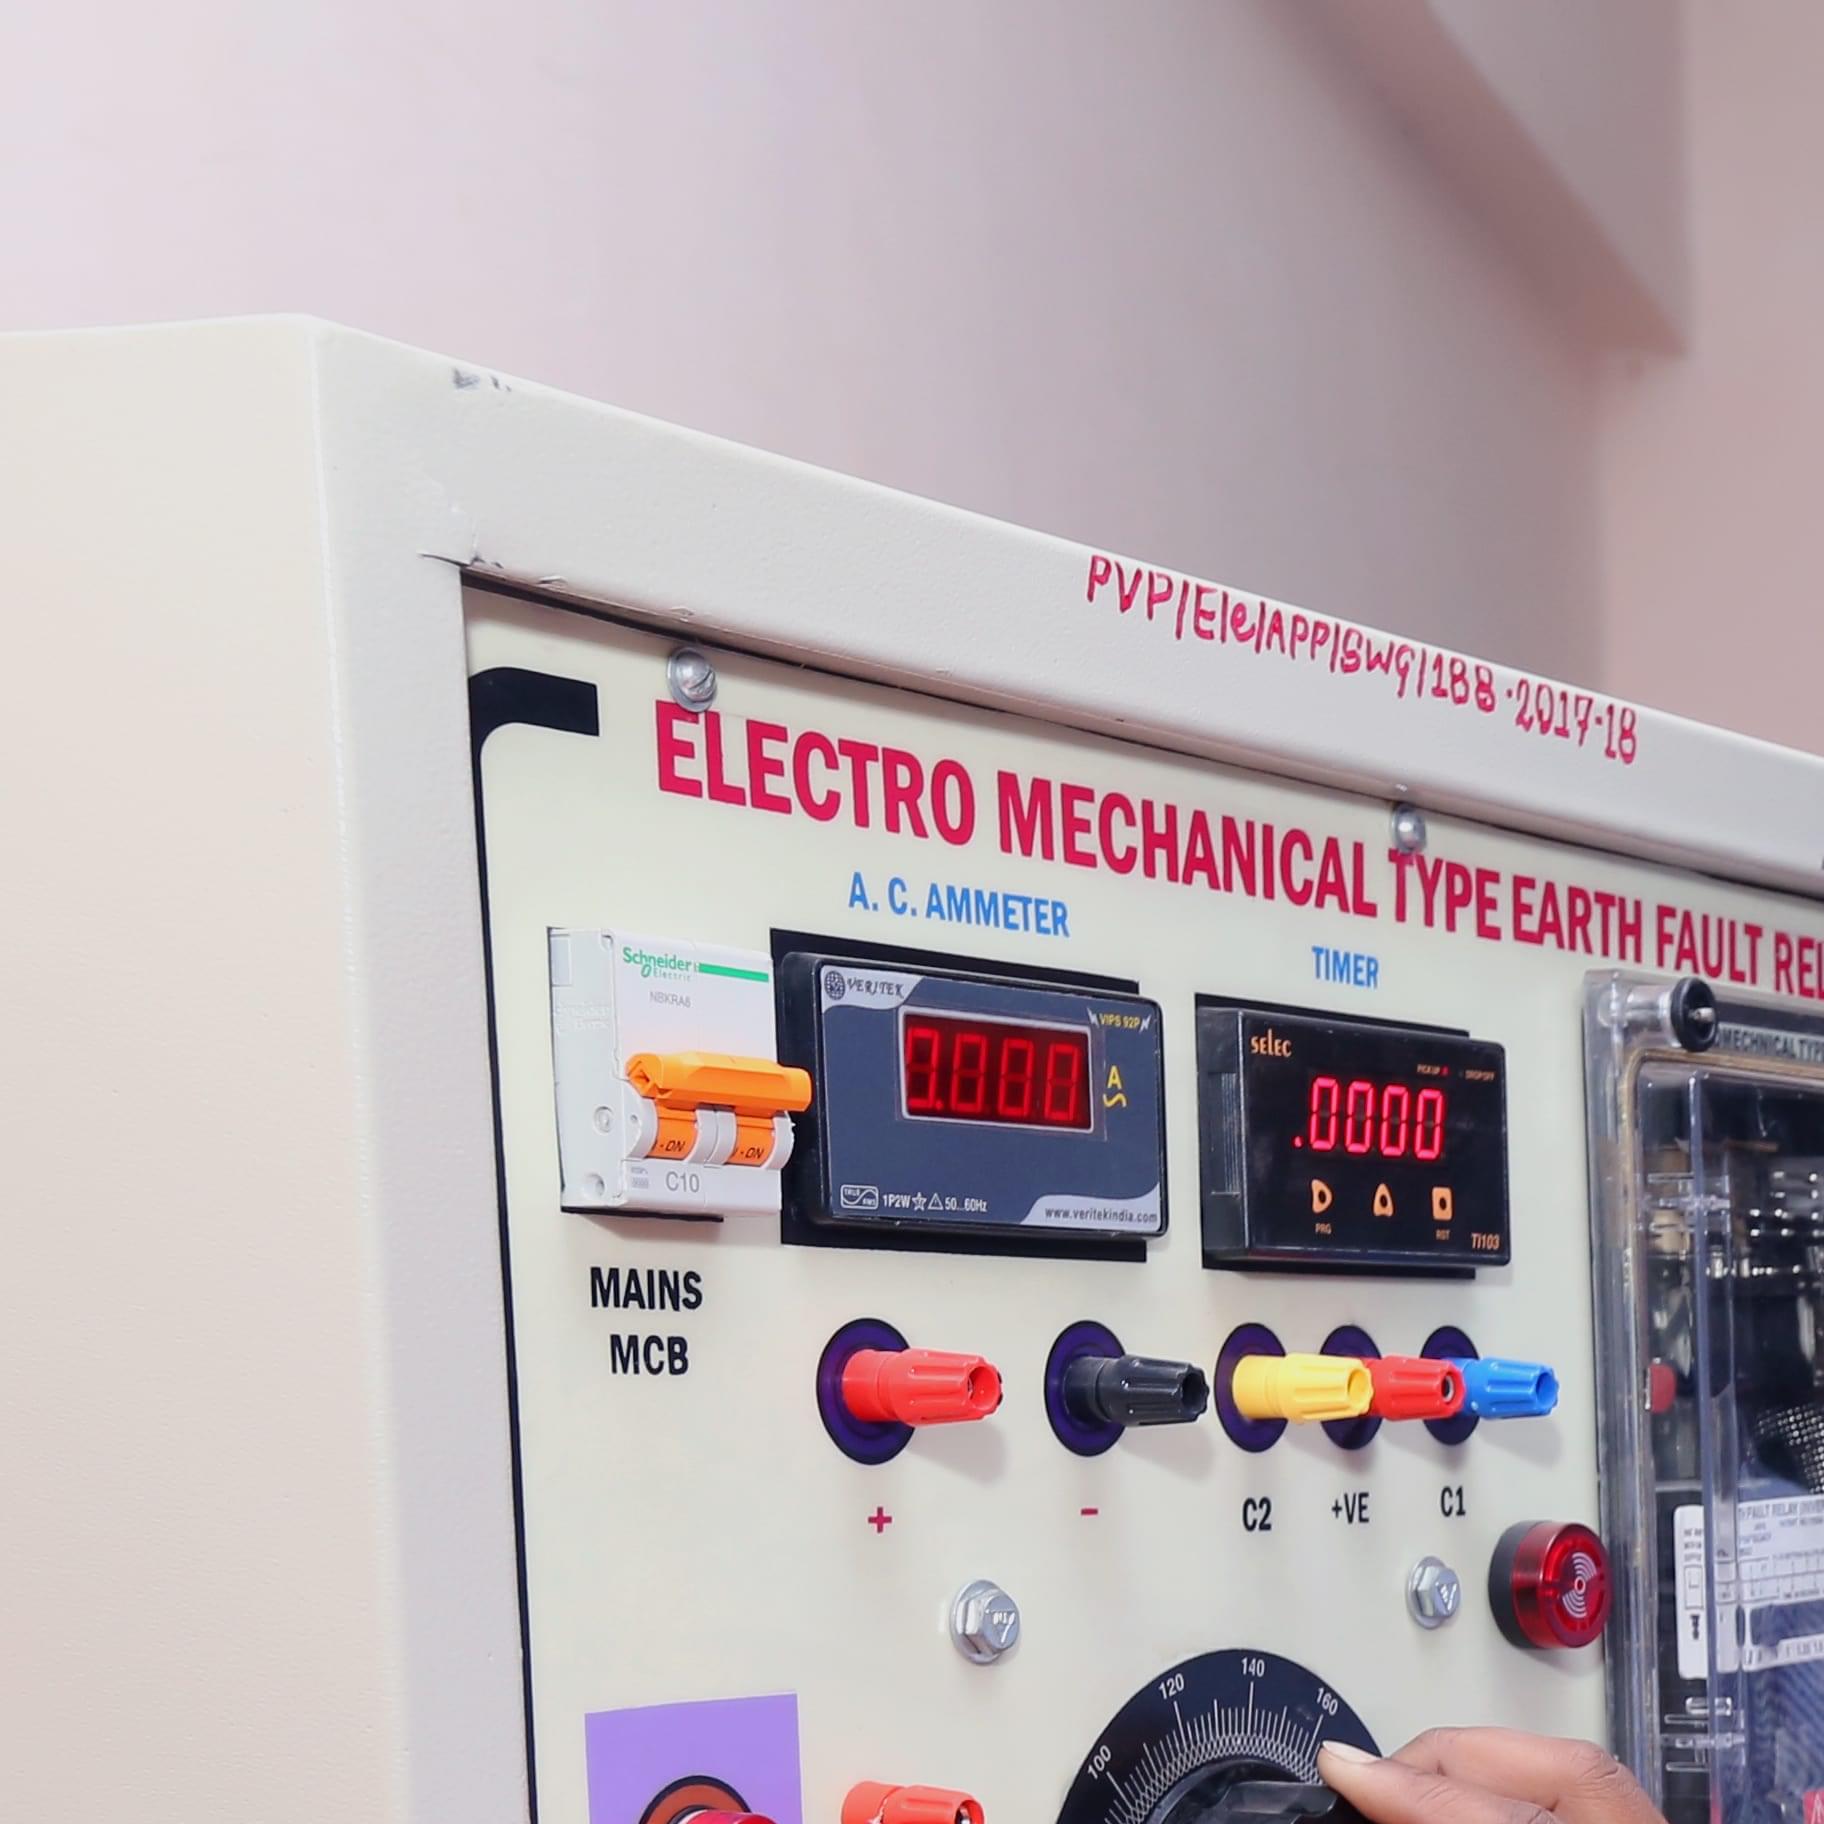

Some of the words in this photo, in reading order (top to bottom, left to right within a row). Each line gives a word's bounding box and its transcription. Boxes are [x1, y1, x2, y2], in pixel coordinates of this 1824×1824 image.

[655, 700, 975, 846] ELECTRO
[997, 770, 1378, 918] MECHANICAL
[1388, 847, 1501, 941] TYPE
[1512, 875, 1642, 964] EARTH
[1656, 905, 1763, 985] FAULT
[926, 882, 1070, 938] AMMETER
[622, 947, 691, 973] Schneider
[1311, 946, 1379, 989] TIMER
[666, 1171, 699, 1193] C10
[590, 1267, 703, 1312] MAINS
[609, 1333, 689, 1376] MCB
[1242, 1497, 1272, 1532] C2
[1331, 1491, 1370, 1523] +VE
[1440, 1486, 1466, 1517] C1
[1241, 1657, 1265, 1677] 140
[1159, 1673, 1185, 1700] 120
[1317, 1686, 1339, 1715] 160
[1087, 1744, 1112, 1780] 100
